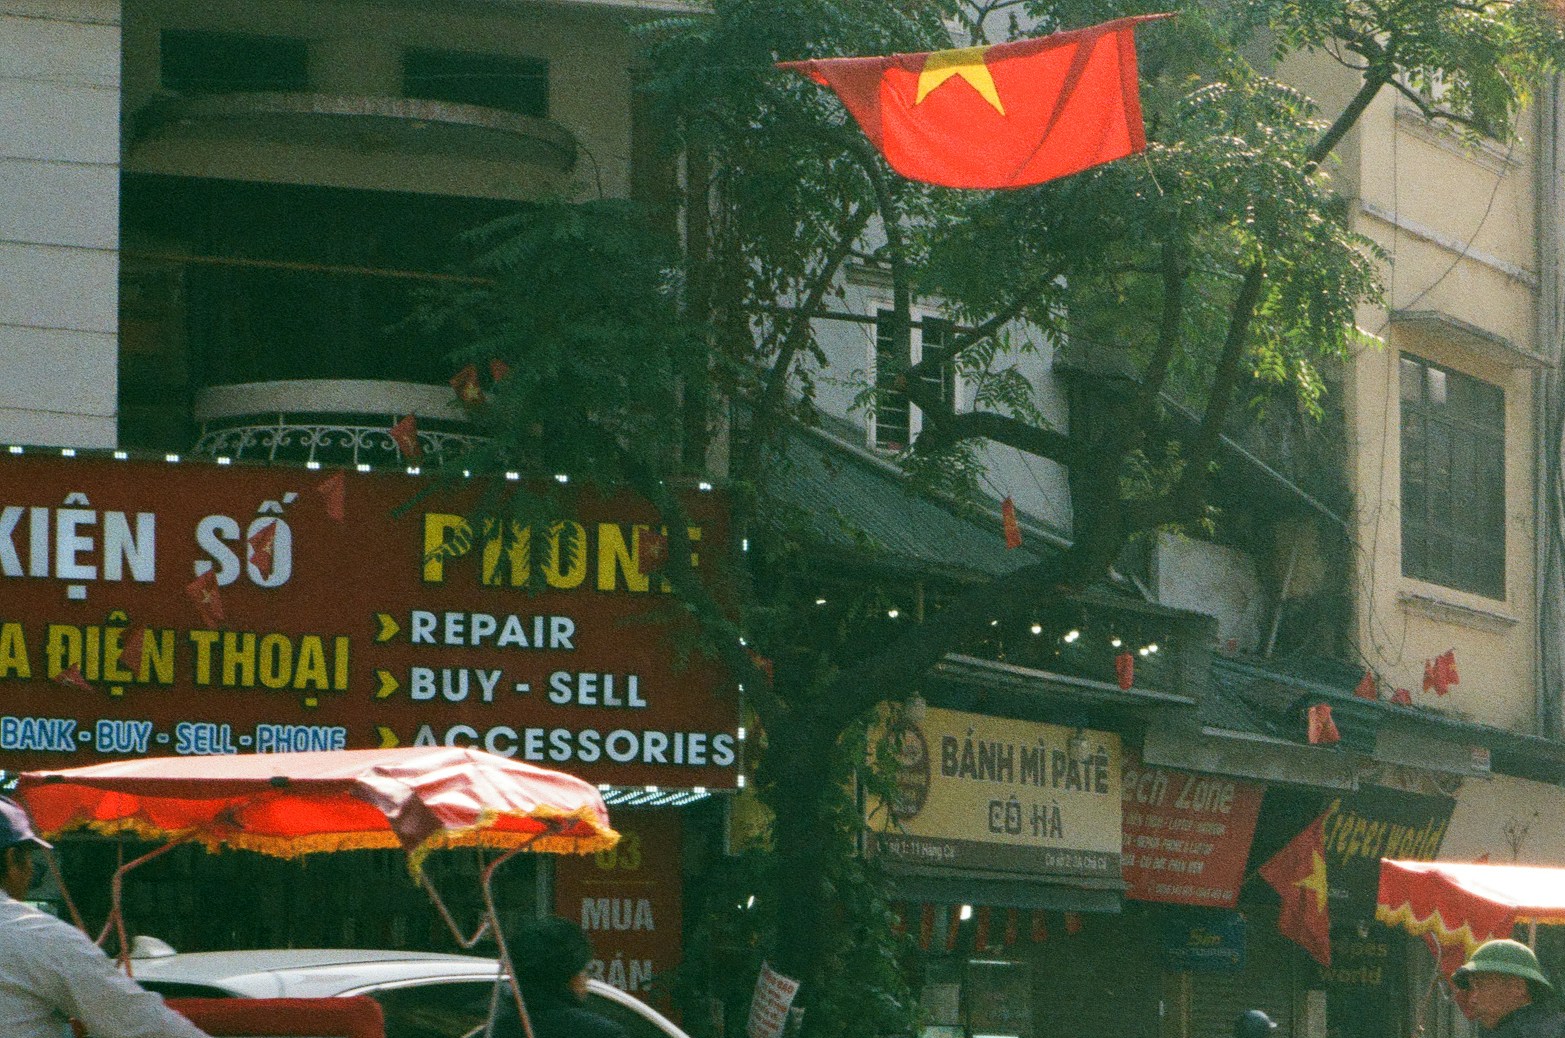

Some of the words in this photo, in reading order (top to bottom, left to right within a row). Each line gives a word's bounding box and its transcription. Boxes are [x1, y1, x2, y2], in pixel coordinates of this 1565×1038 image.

[195, 492, 298, 588] SỐ
[423, 512, 702, 593] PHON
[411, 610, 577, 651] REPAIR
[46, 610, 176, 696] ĐIỆN
[190, 628, 350, 707] THOẠI
[411, 666, 502, 703] BUY
[547, 671, 647, 709] SELL
[0, 716, 77, 752] BANK
[95, 719, 153, 754] BUY
[175, 721, 237, 755] SELL
[256, 723, 347, 754] PHONE
[414, 724, 736, 768] ACCESSORIES
[942, 727, 1014, 783] BÁNH
[1020, 738, 1047, 787] MÌ
[1174, 773, 1236, 814] Zone
[988, 795, 1022, 835] CÔ
[1031, 800, 1064, 839] HÀ
[581, 898, 655, 931] MUA
